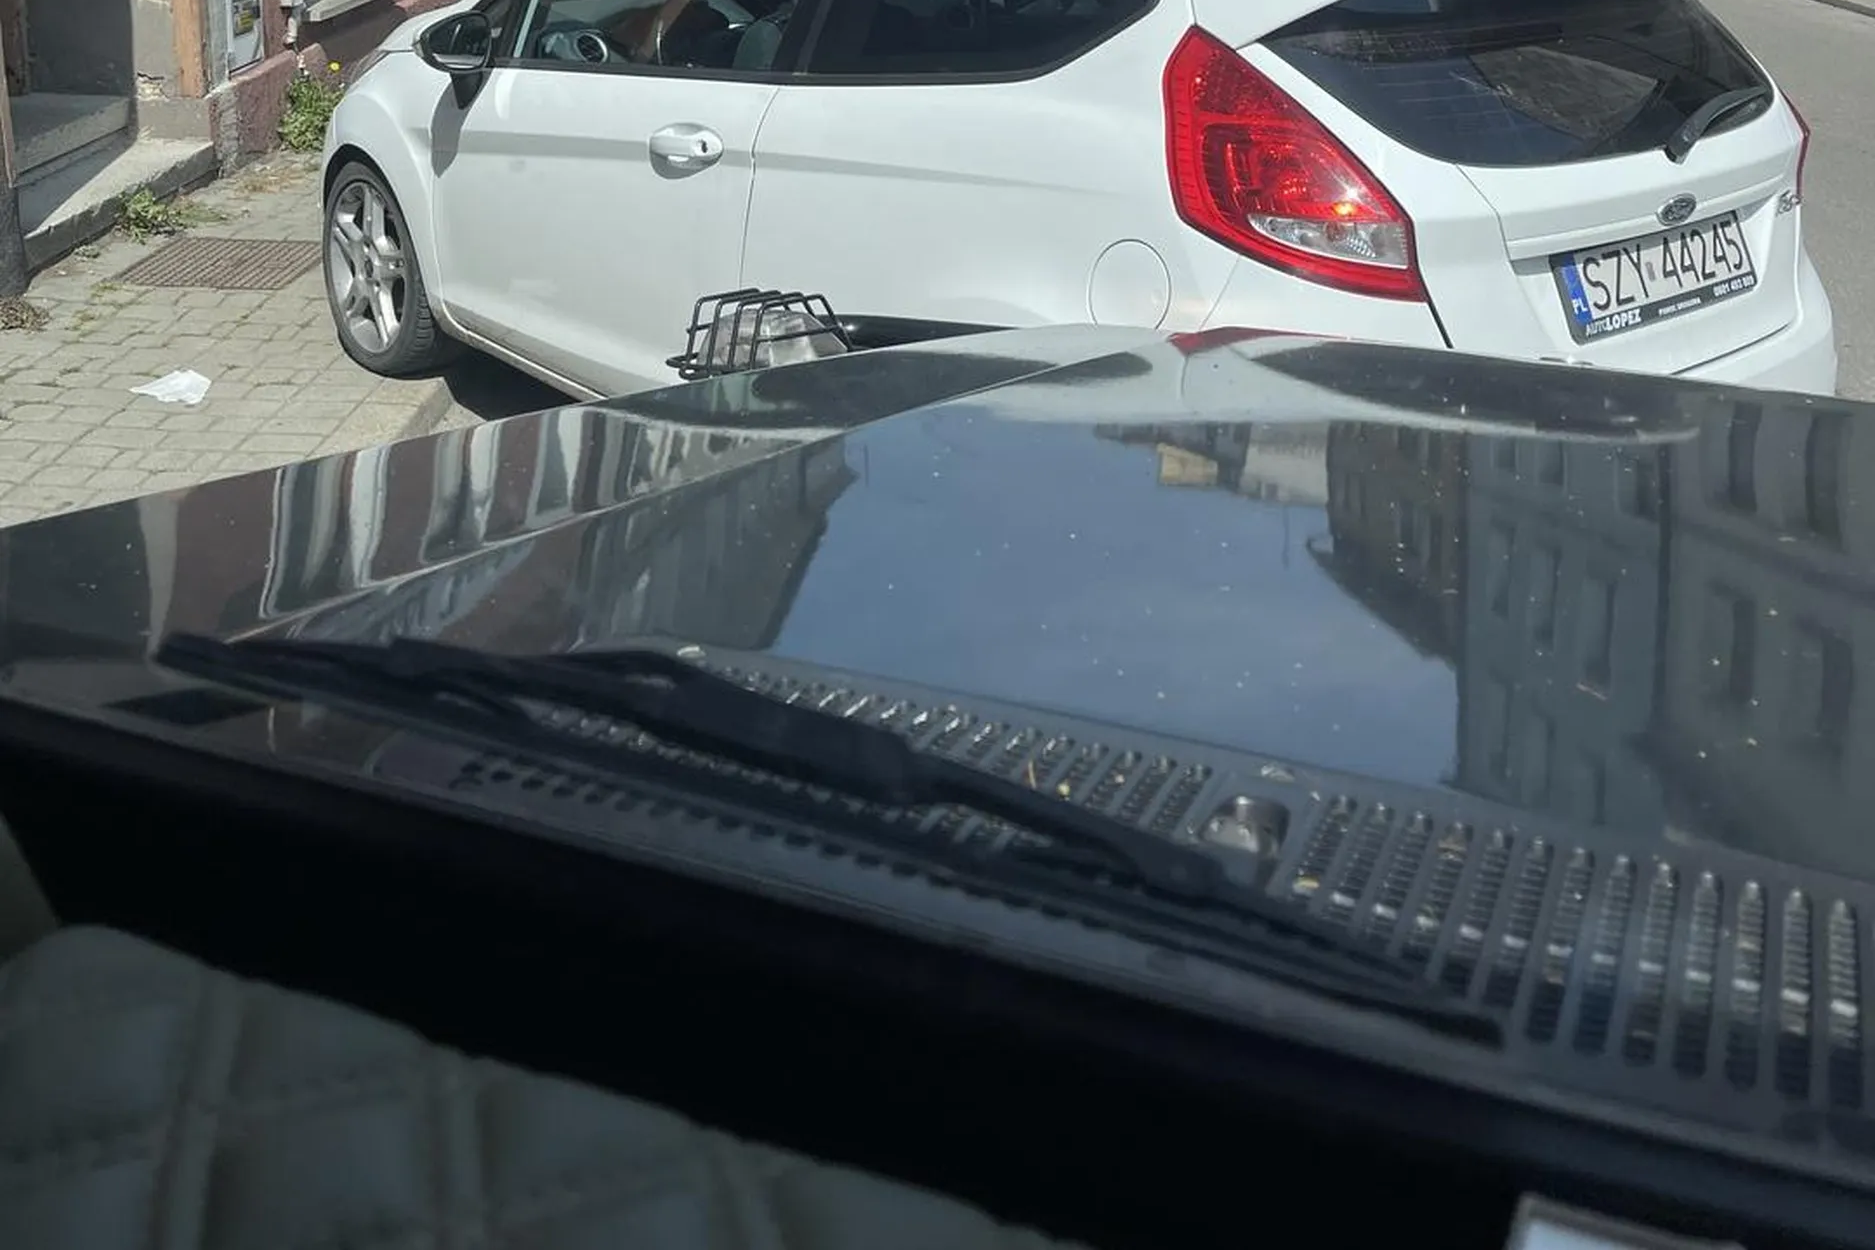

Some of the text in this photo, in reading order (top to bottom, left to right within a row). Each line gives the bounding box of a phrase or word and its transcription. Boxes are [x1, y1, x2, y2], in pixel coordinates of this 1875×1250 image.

[1582, 221, 1743, 312] SZY 44245
[1572, 297, 1588, 315] PL
